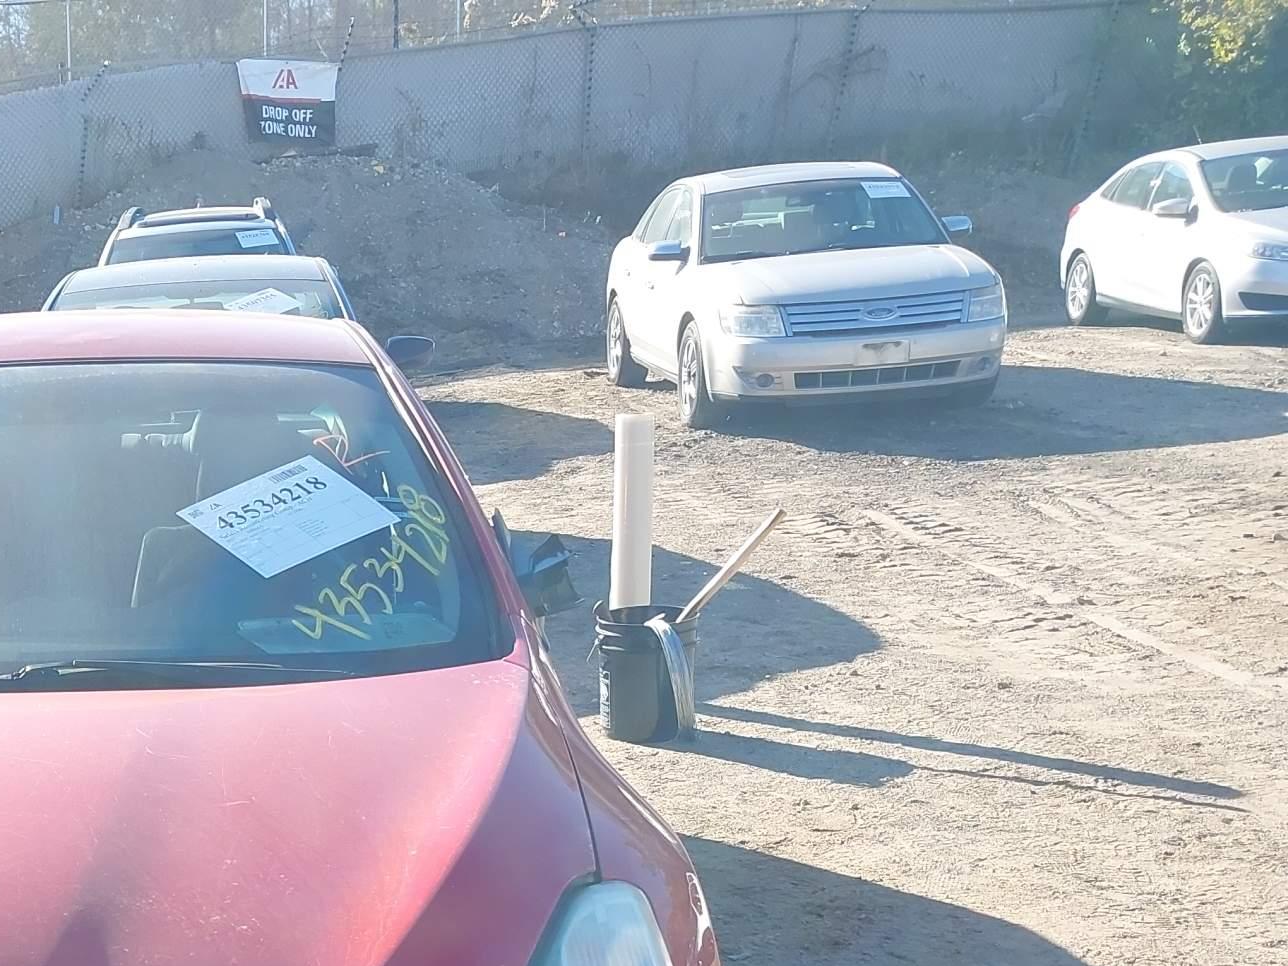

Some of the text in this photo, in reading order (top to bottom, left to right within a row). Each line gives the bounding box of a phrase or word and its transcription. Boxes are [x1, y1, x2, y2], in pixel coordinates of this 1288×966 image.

[259, 120, 317, 138] ZONE ONLY
[262, 105, 313, 123] DROP OFF
[217, 476, 328, 530] 43534218
[291, 484, 450, 641] 43534218
